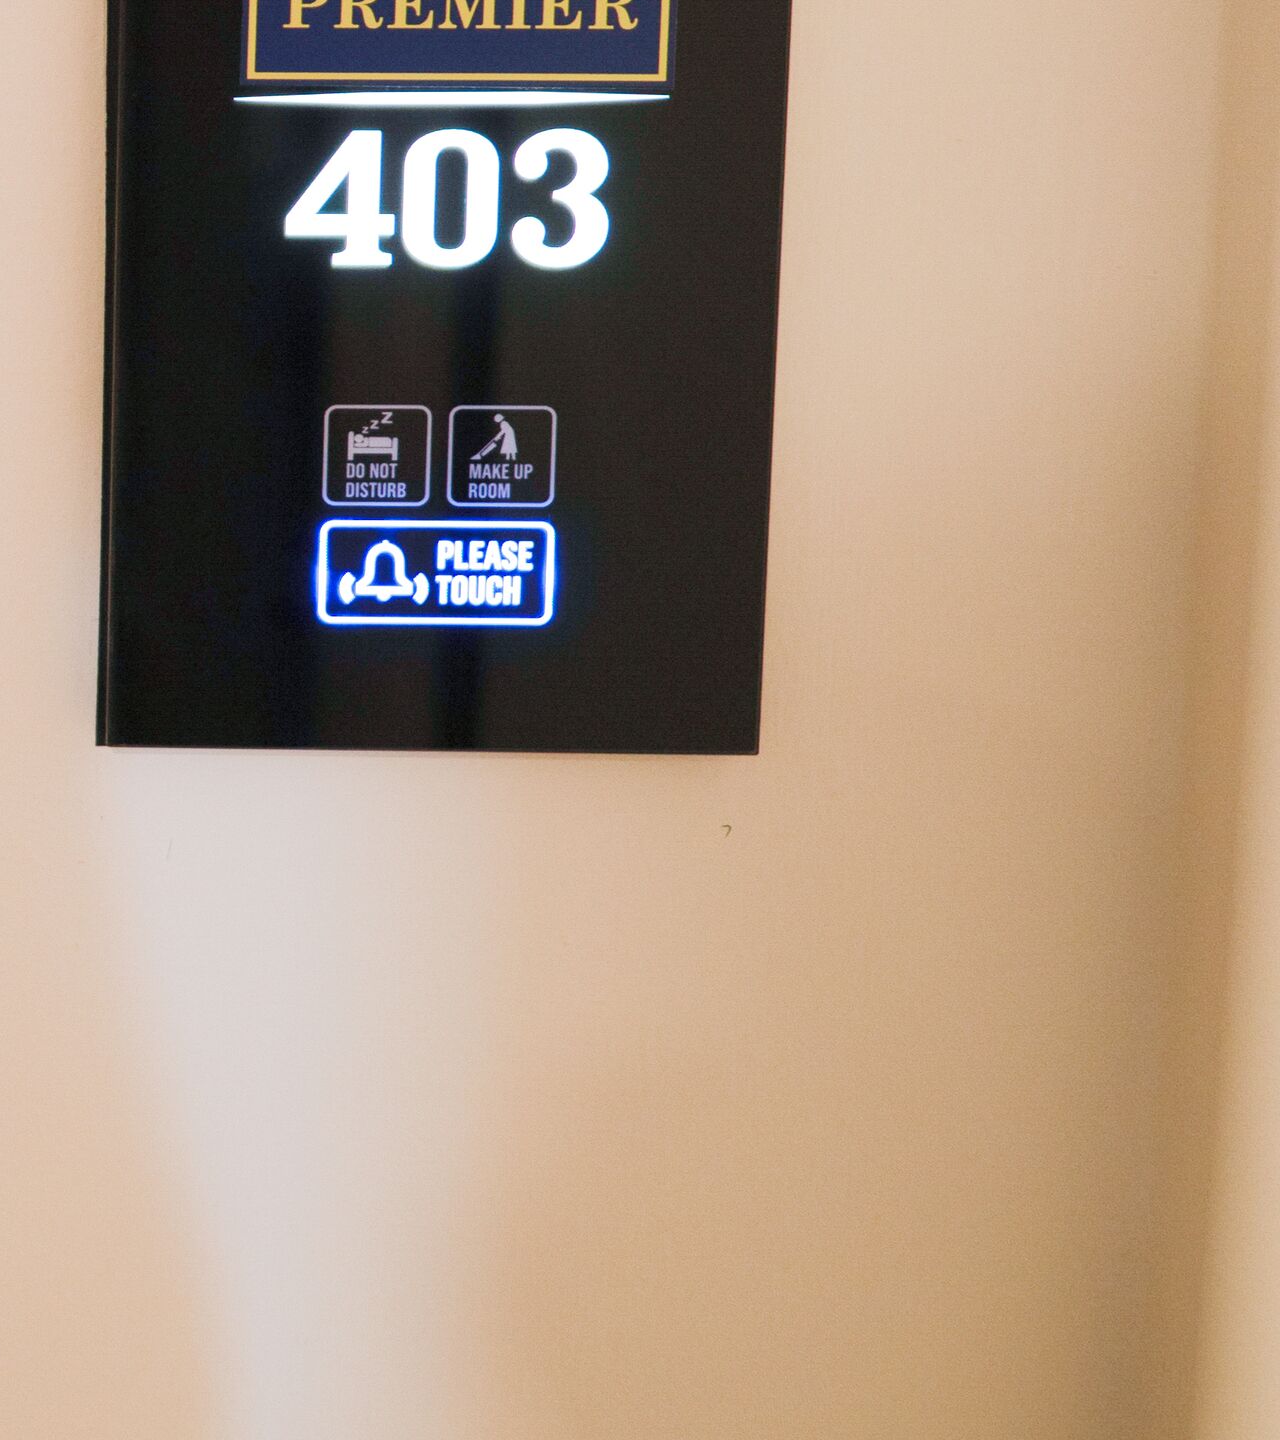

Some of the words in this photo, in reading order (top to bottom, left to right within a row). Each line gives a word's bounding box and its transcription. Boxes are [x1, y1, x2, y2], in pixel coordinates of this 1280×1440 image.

[284, 127, 611, 271] 403
[346, 462, 365, 479] DO
[369, 462, 398, 479] NOT
[469, 463, 509, 479] MAKE
[514, 464, 534, 480] UP
[345, 482, 407, 498] DISTURB
[468, 483, 511, 499] ROOM
[436, 540, 535, 572] PLEASE
[435, 574, 522, 606] TOUCH
